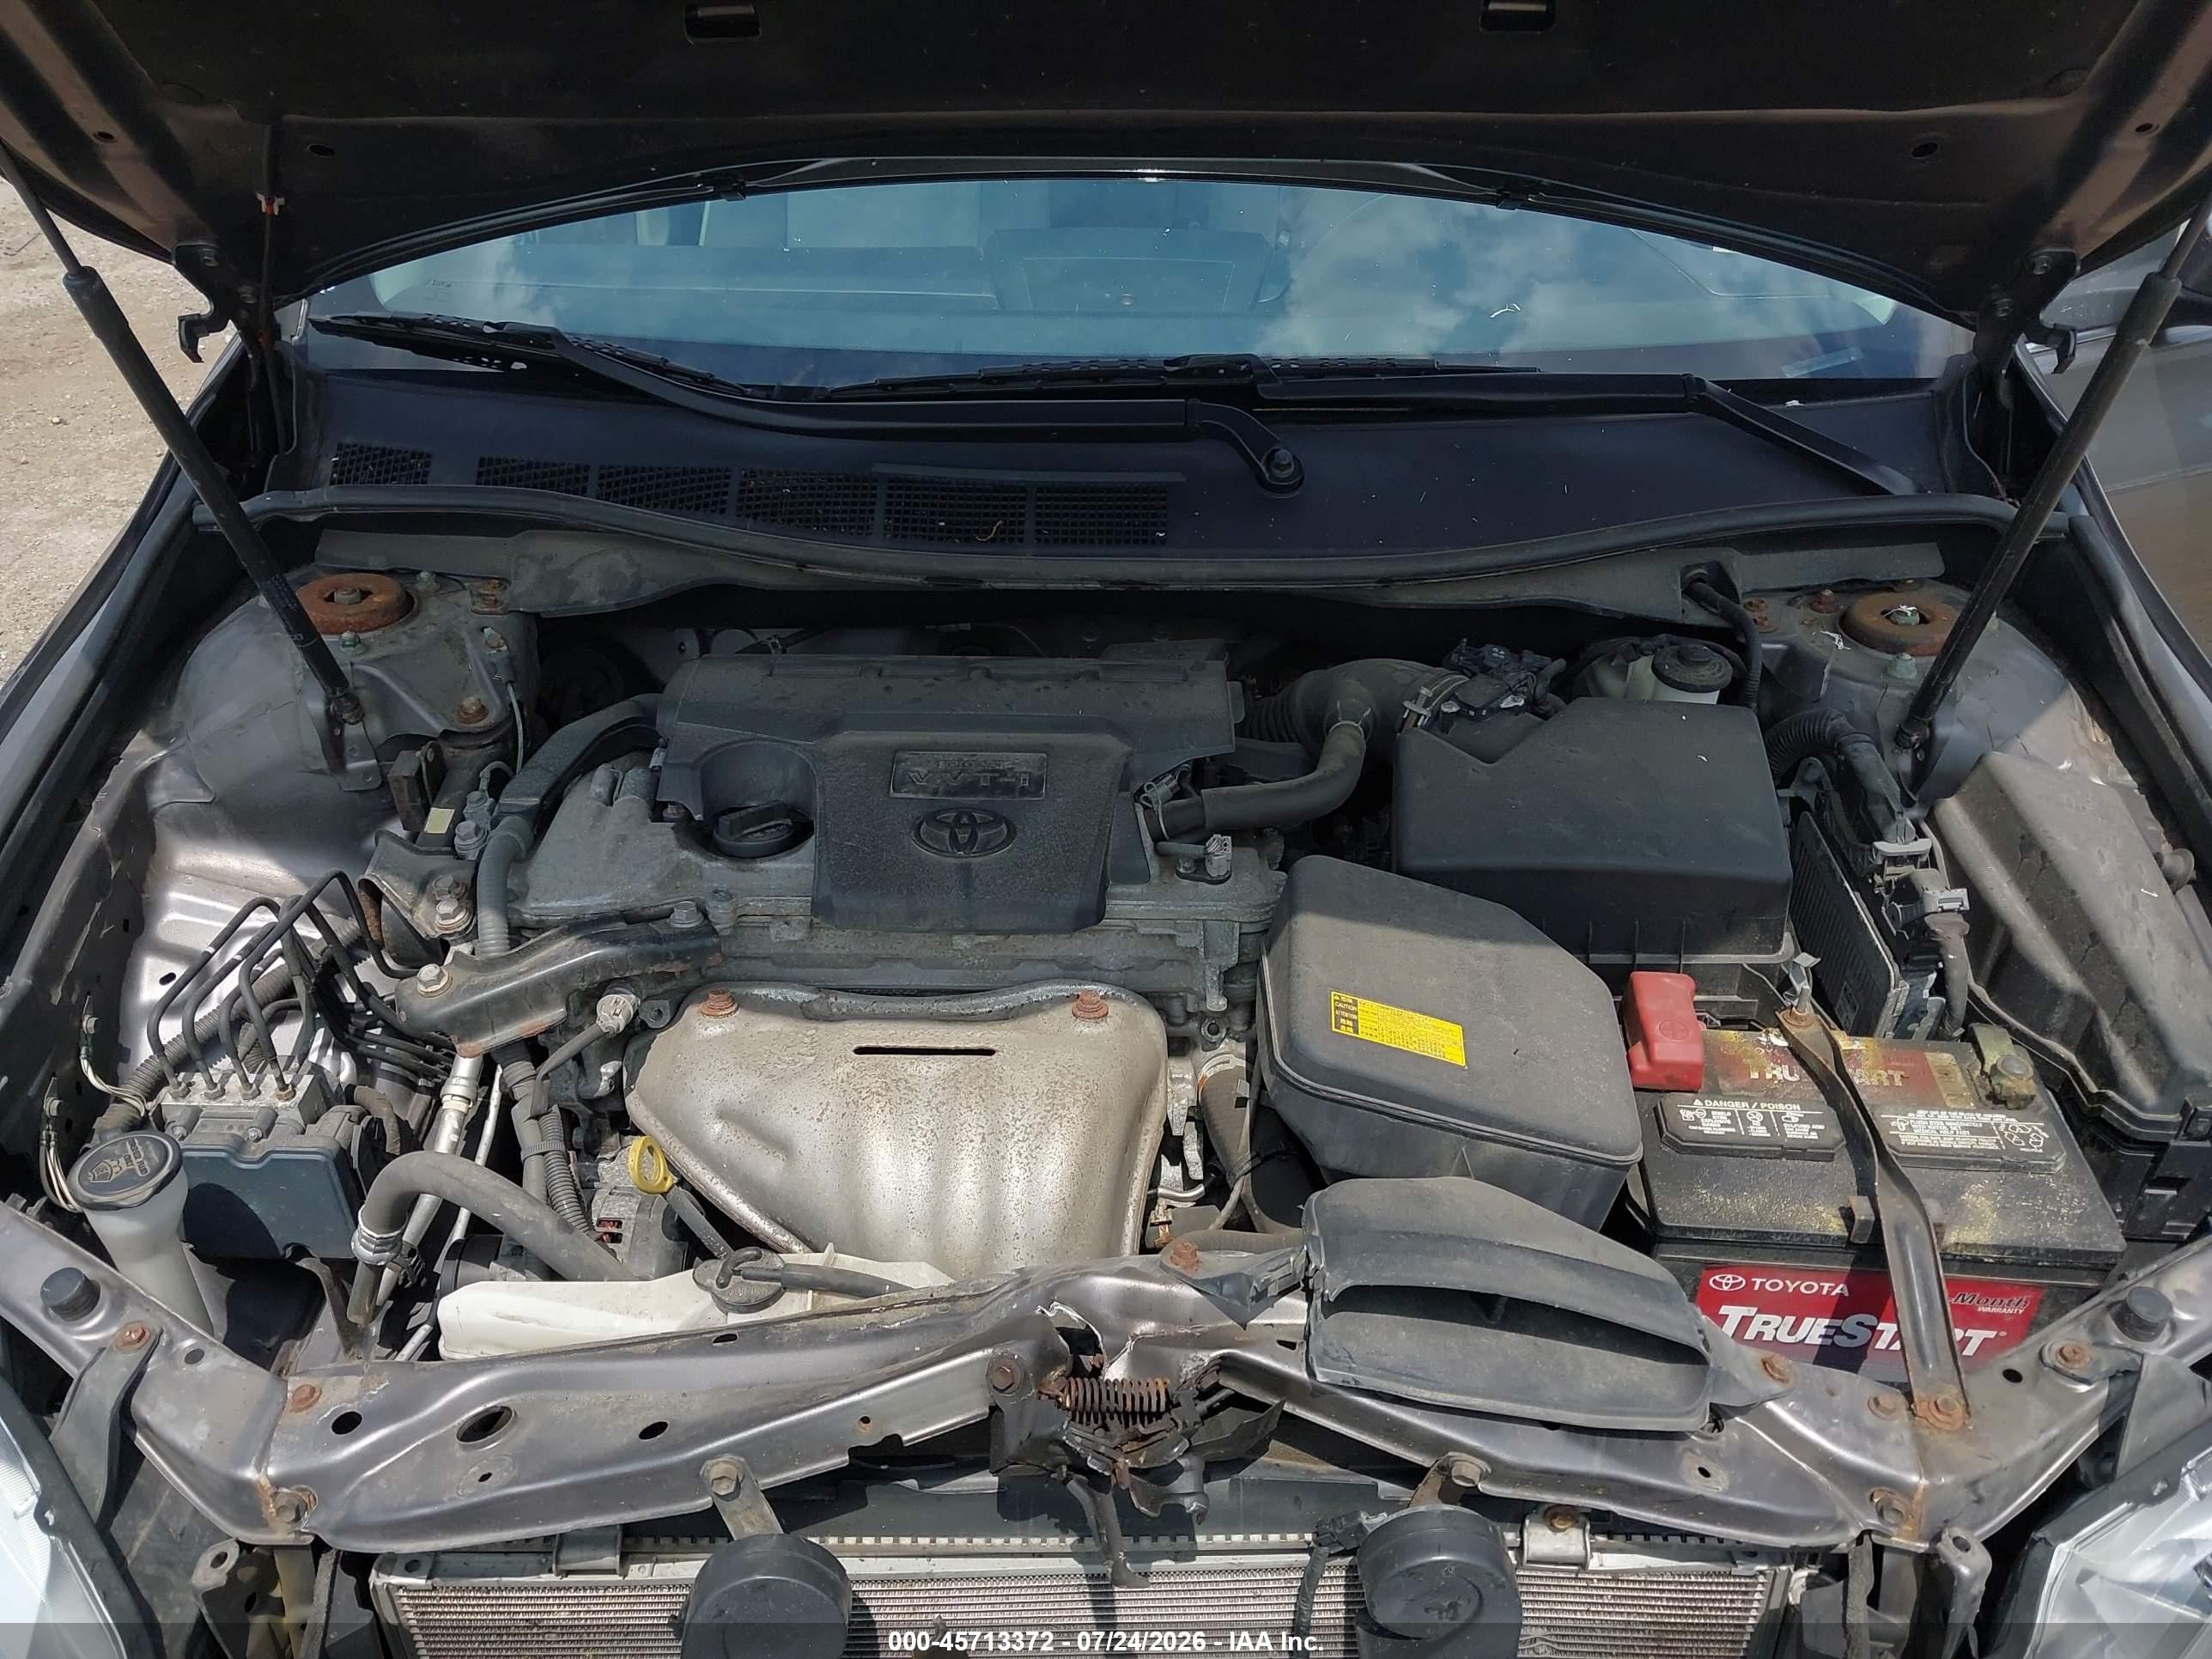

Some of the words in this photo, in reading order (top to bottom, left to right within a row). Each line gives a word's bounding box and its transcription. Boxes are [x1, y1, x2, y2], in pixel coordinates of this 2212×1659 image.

[1705, 1099, 1749, 1109] DANGER
[1760, 1103, 1802, 1111] POISON
[1751, 1278, 1850, 1297] TOYOTA
[1978, 1306, 2025, 1316] WARRANTY
